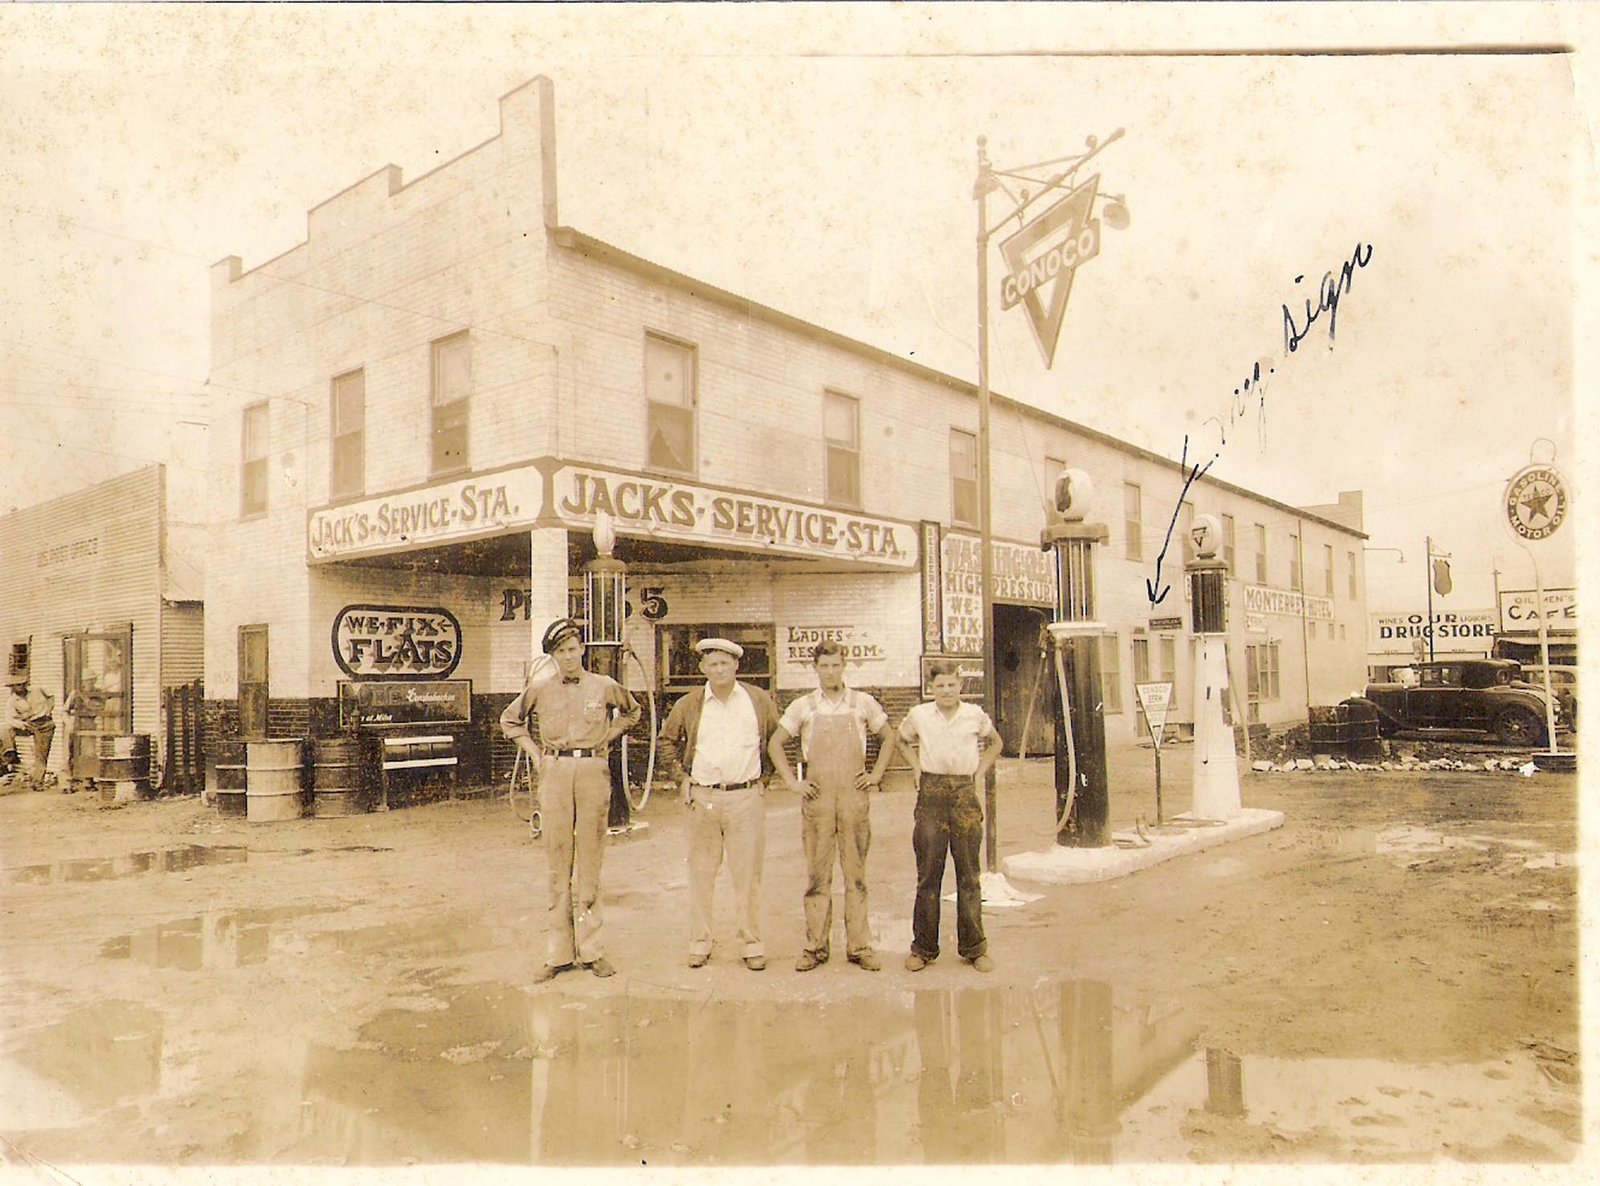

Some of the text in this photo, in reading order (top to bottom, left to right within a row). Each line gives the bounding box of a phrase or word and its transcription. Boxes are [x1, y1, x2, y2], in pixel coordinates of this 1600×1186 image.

[1004, 228, 1094, 303] CONOCO
[1283, 242, 1373, 357] sign
[1510, 515, 1552, 538] MOTOR
[1408, 614, 1457, 624] OUR
[1508, 604, 1577, 620] CAFE
[347, 633, 453, 668] FLATS
[788, 645, 878, 658] RES OOM
